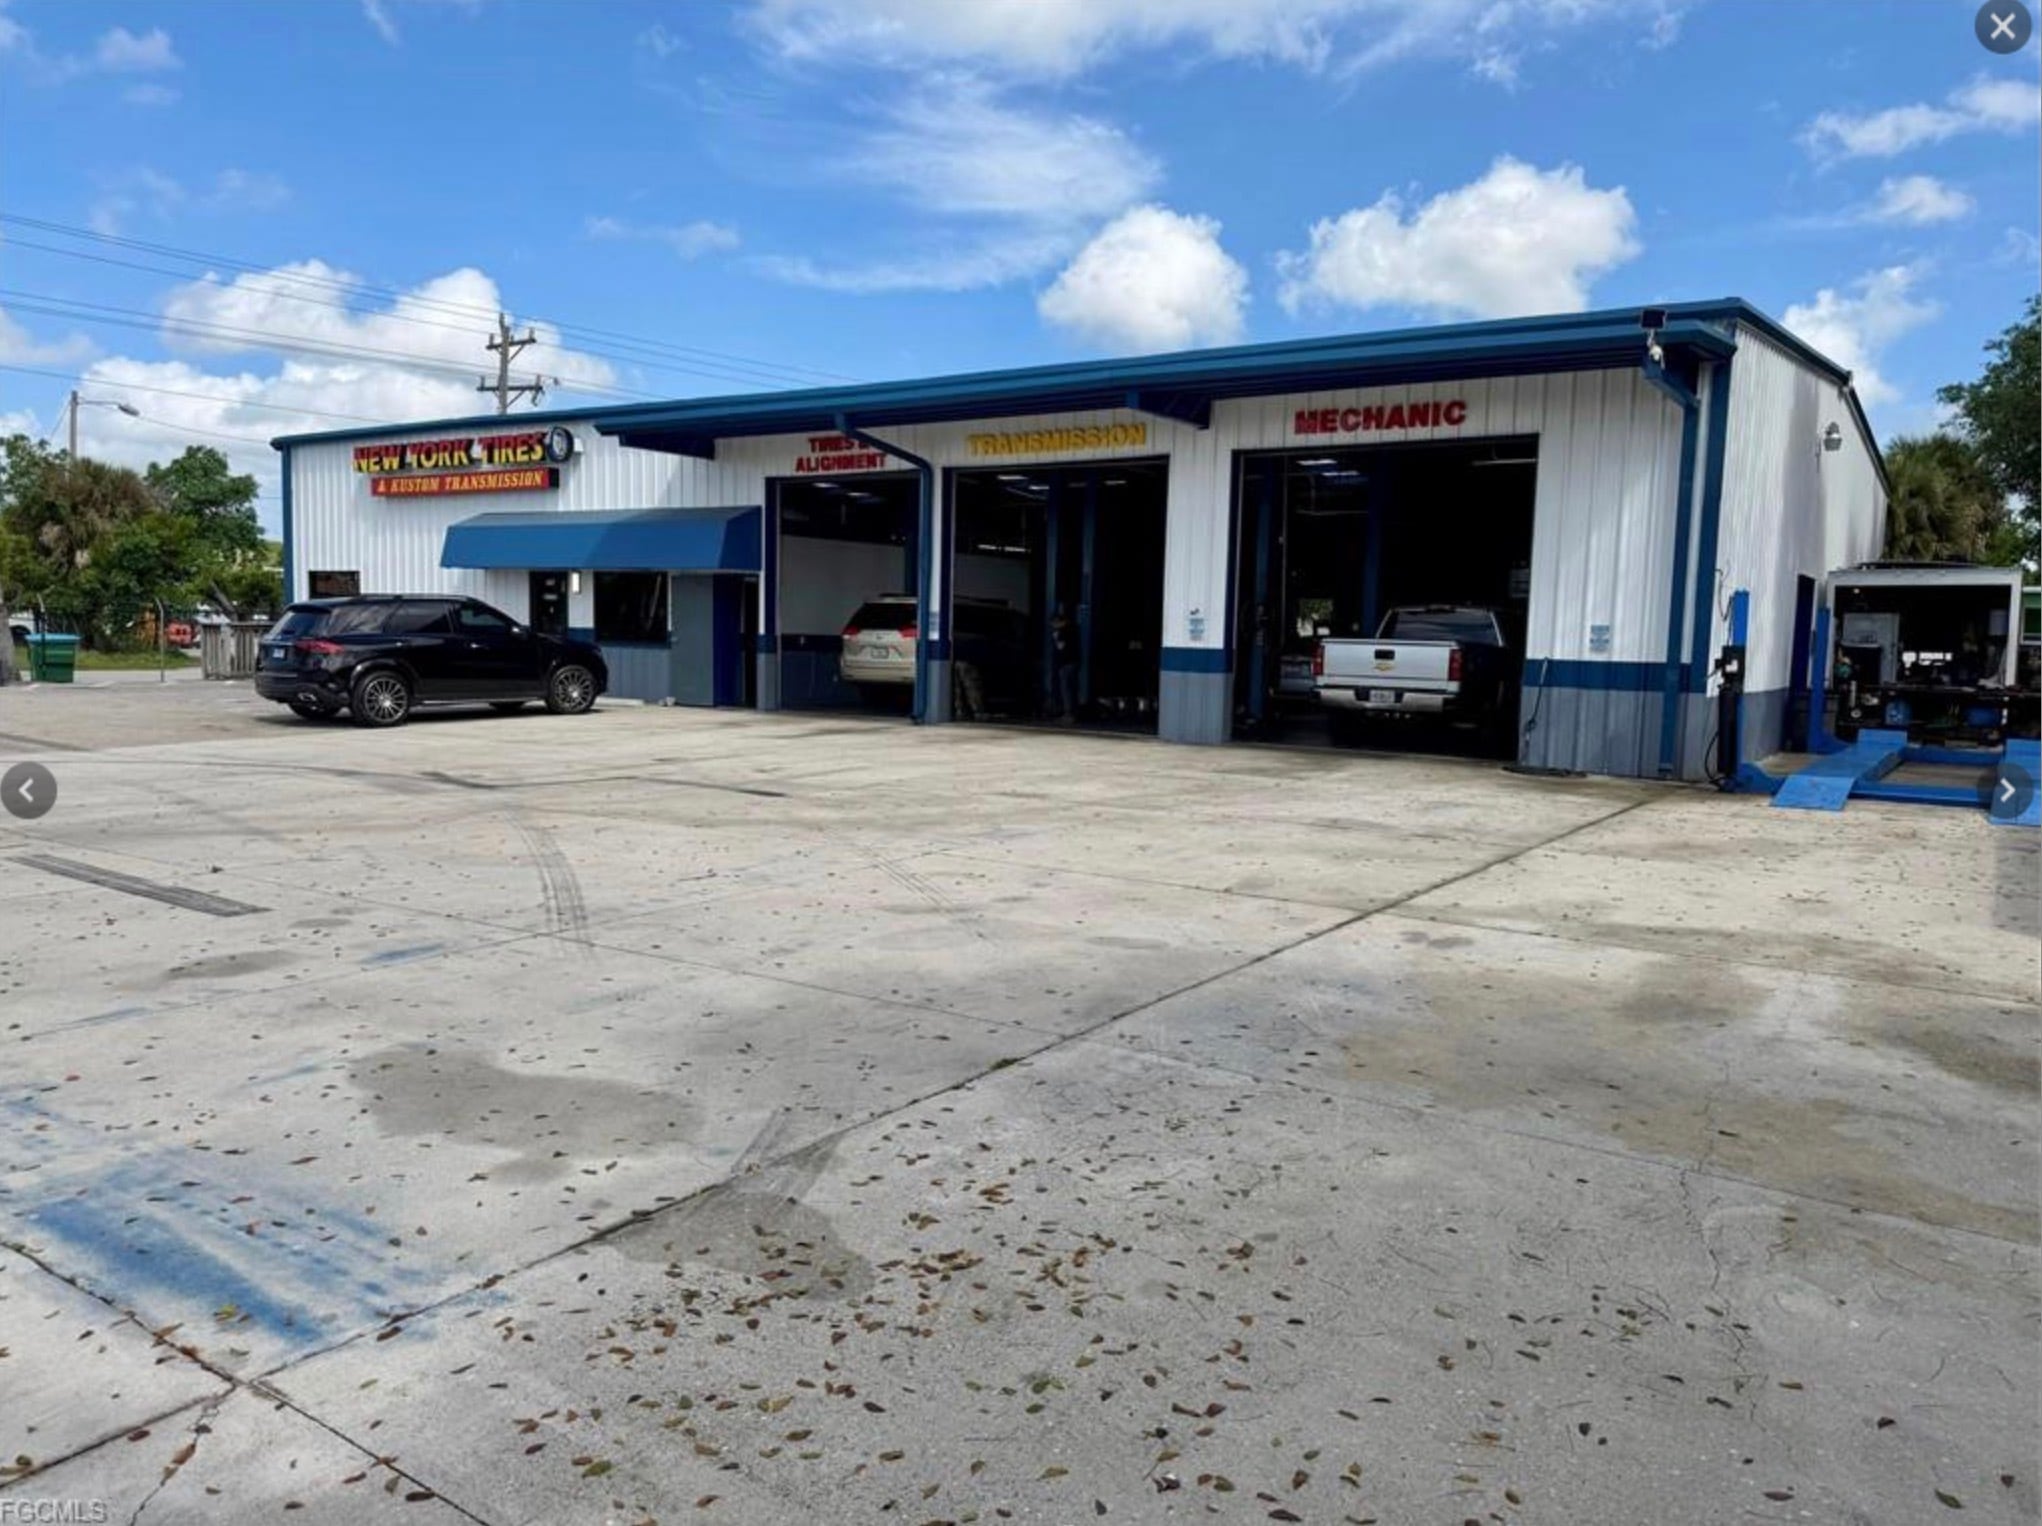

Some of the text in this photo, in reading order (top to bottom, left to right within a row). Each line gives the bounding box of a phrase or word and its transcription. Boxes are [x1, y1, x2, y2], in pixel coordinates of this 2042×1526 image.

[1294, 401, 1467, 434] MECHANIC
[352, 432, 545, 473] NEW YORK TIRES
[808, 435, 856, 453] TIRES
[966, 422, 1147, 457] TRANSMISSION
[795, 452, 887, 472] ALIGNMENT
[390, 476, 440, 493] KUSTOM
[445, 470, 544, 491] TRANSMISSION
